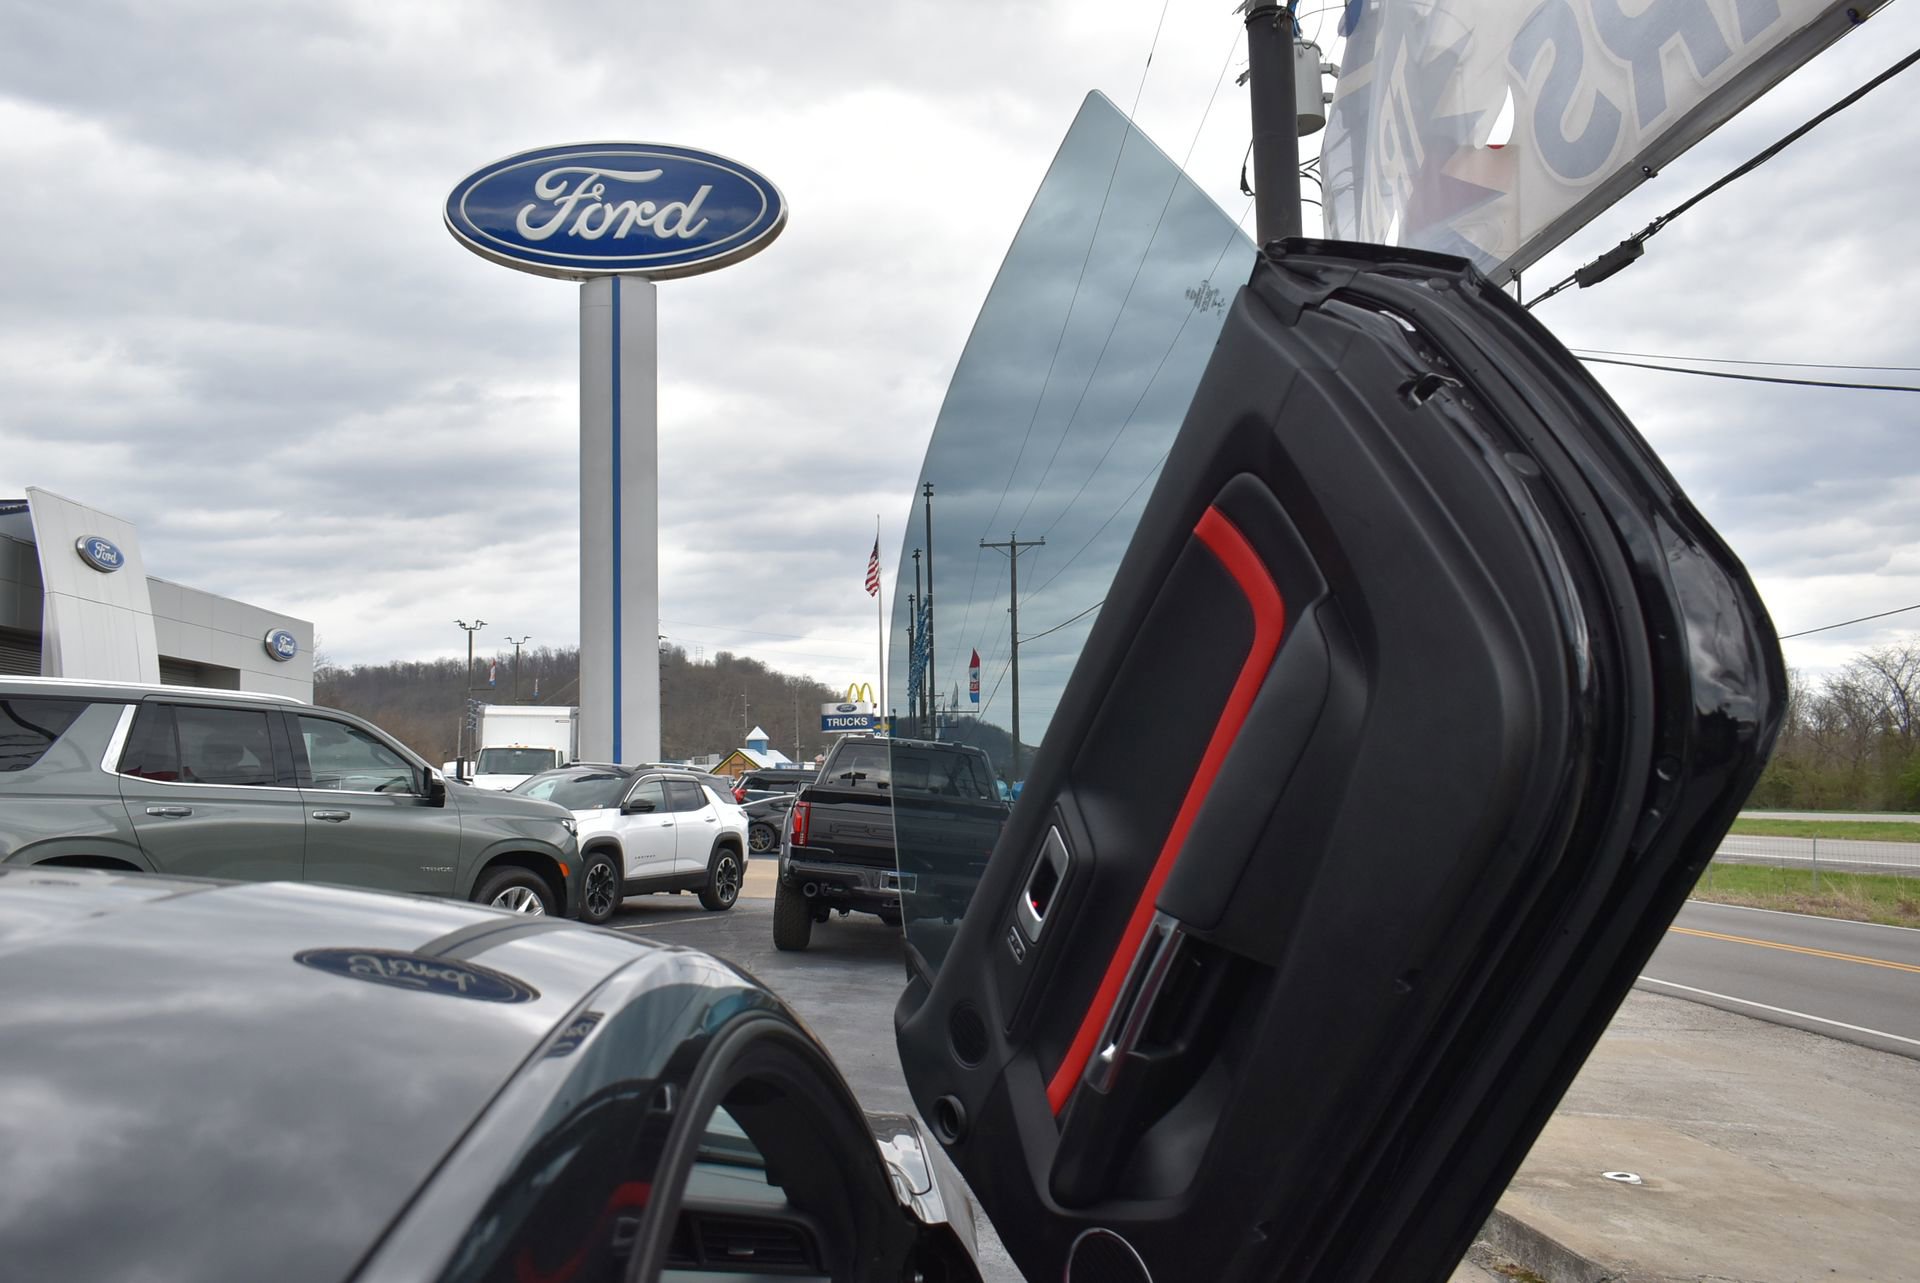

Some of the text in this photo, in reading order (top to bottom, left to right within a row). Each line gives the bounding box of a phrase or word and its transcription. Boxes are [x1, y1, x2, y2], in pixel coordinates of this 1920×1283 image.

[515, 166, 713, 241] Ford
[94, 542, 117, 564] Ford
[278, 635, 294, 654] Ford
[826, 717, 868, 726] TRUCKS
